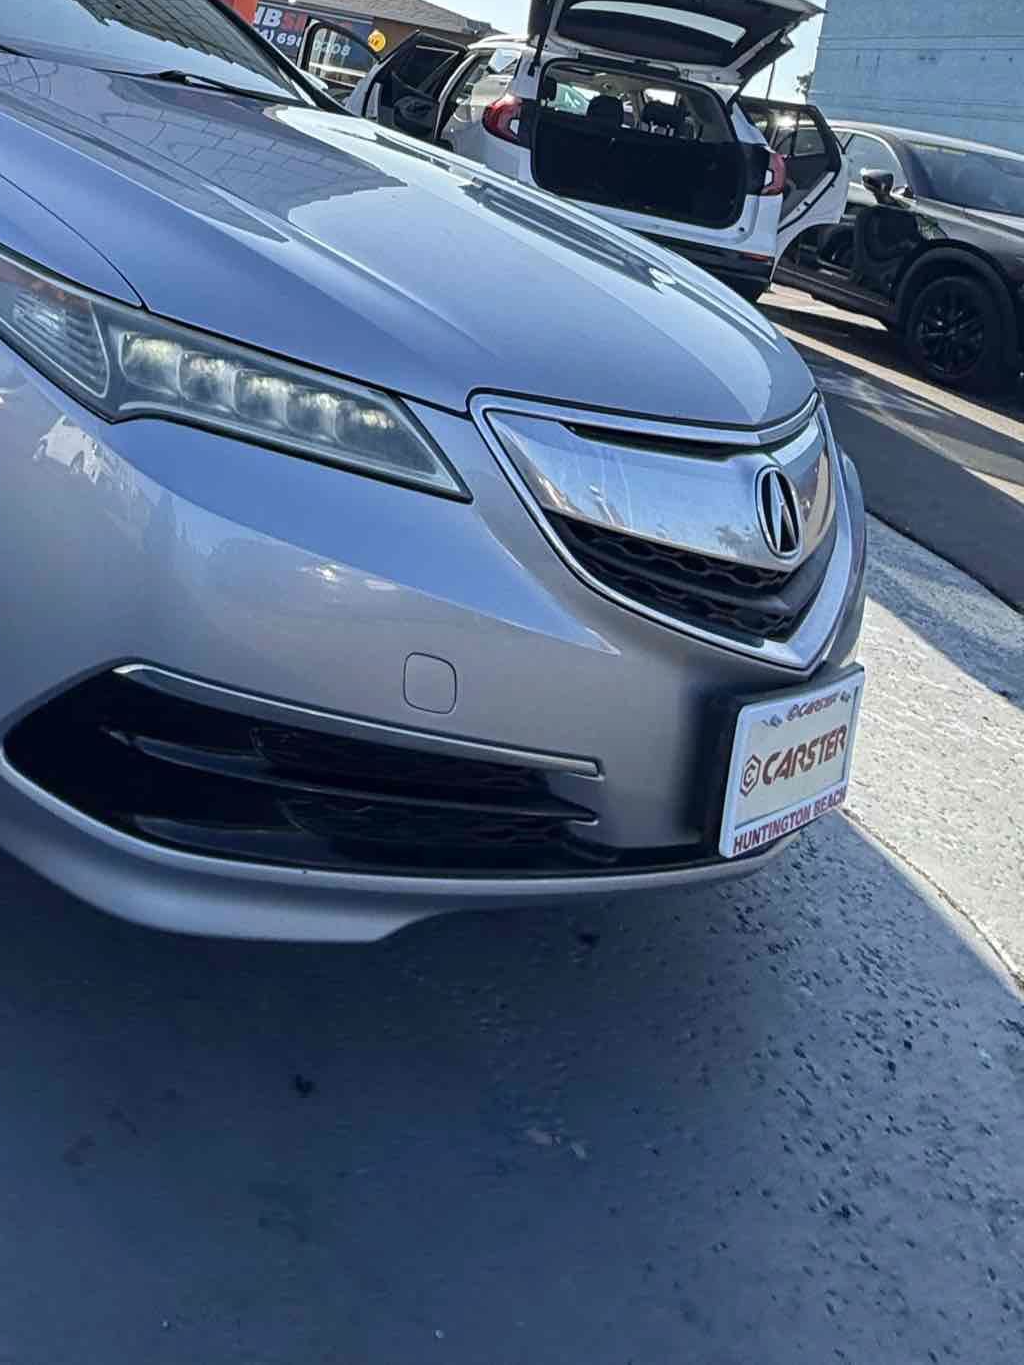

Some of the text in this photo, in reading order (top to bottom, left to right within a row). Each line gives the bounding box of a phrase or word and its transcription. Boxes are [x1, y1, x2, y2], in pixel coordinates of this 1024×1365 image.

[762, 724, 848, 786] CARSTER
[732, 785, 848, 854] HUNTINGTON BEACH
